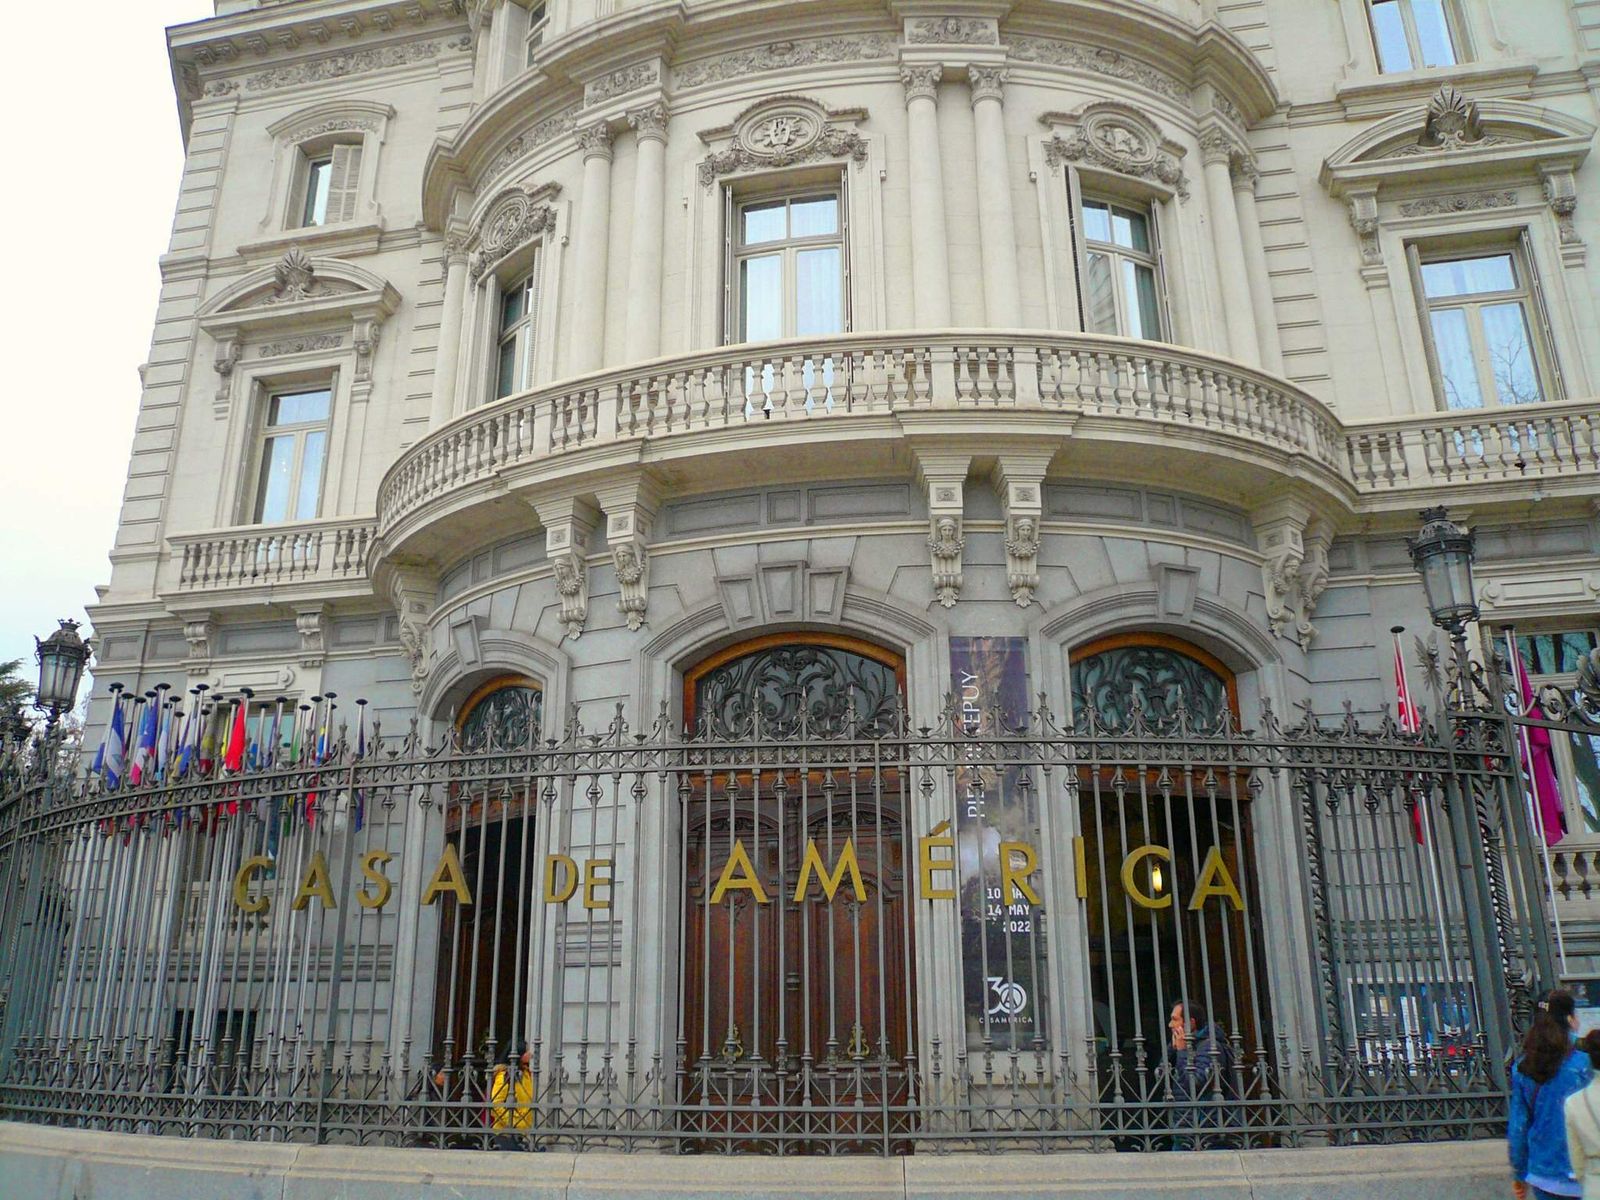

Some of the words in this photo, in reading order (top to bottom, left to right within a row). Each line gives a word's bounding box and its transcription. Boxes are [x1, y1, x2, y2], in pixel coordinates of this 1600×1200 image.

[966, 782, 985, 818] PIE
[233, 842, 472, 913] CASA
[543, 853, 614, 909] DE
[709, 817, 1245, 912] AMÉRICA
[986, 887, 1001, 899] 10
[987, 904, 1002, 916] 14
[1008, 904, 1030, 916] MAY
